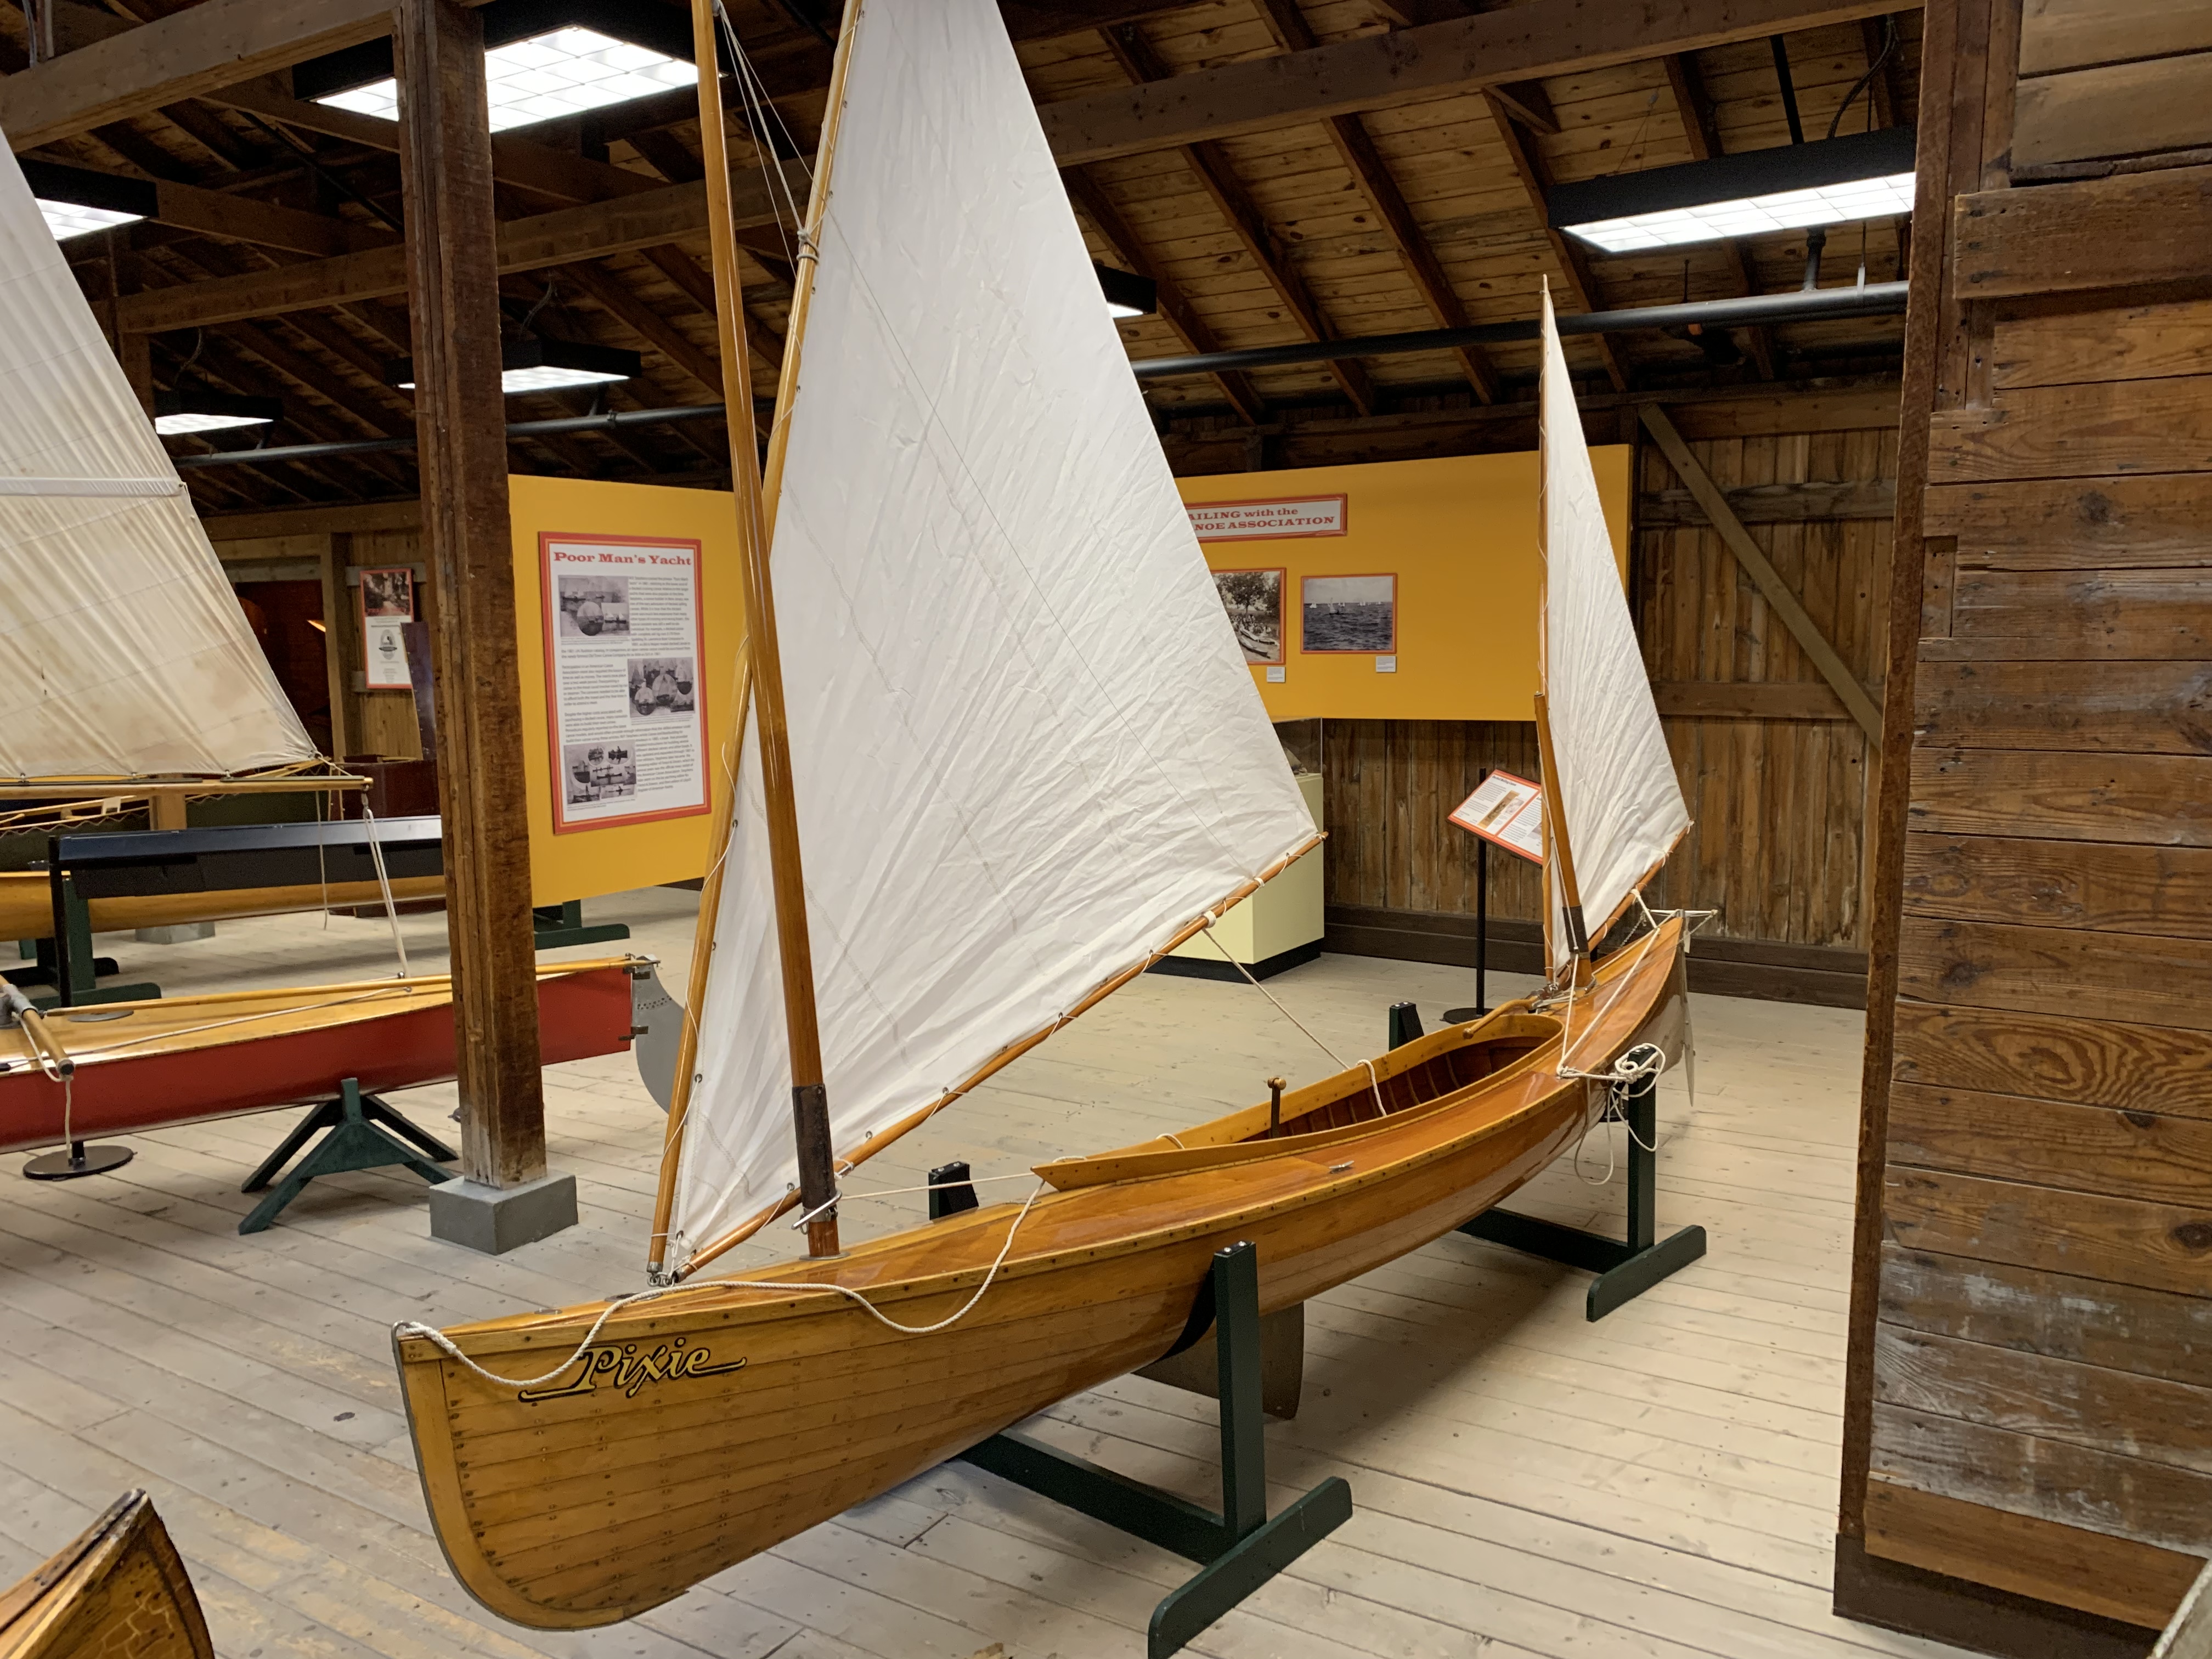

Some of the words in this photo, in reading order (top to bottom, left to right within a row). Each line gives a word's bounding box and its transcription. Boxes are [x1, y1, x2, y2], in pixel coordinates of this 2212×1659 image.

[1188, 511, 1241, 521] AILING
[1244, 509, 1274, 517] with
[1277, 507, 1298, 516] the
[1194, 522, 1225, 531] NOE
[1227, 516, 1335, 529] ASSOCIATION
[553, 552, 595, 562] Poor
[598, 553, 646, 564] Man's
[648, 555, 691, 566] Yacht
[517, 1336, 747, 1403] Pixie
